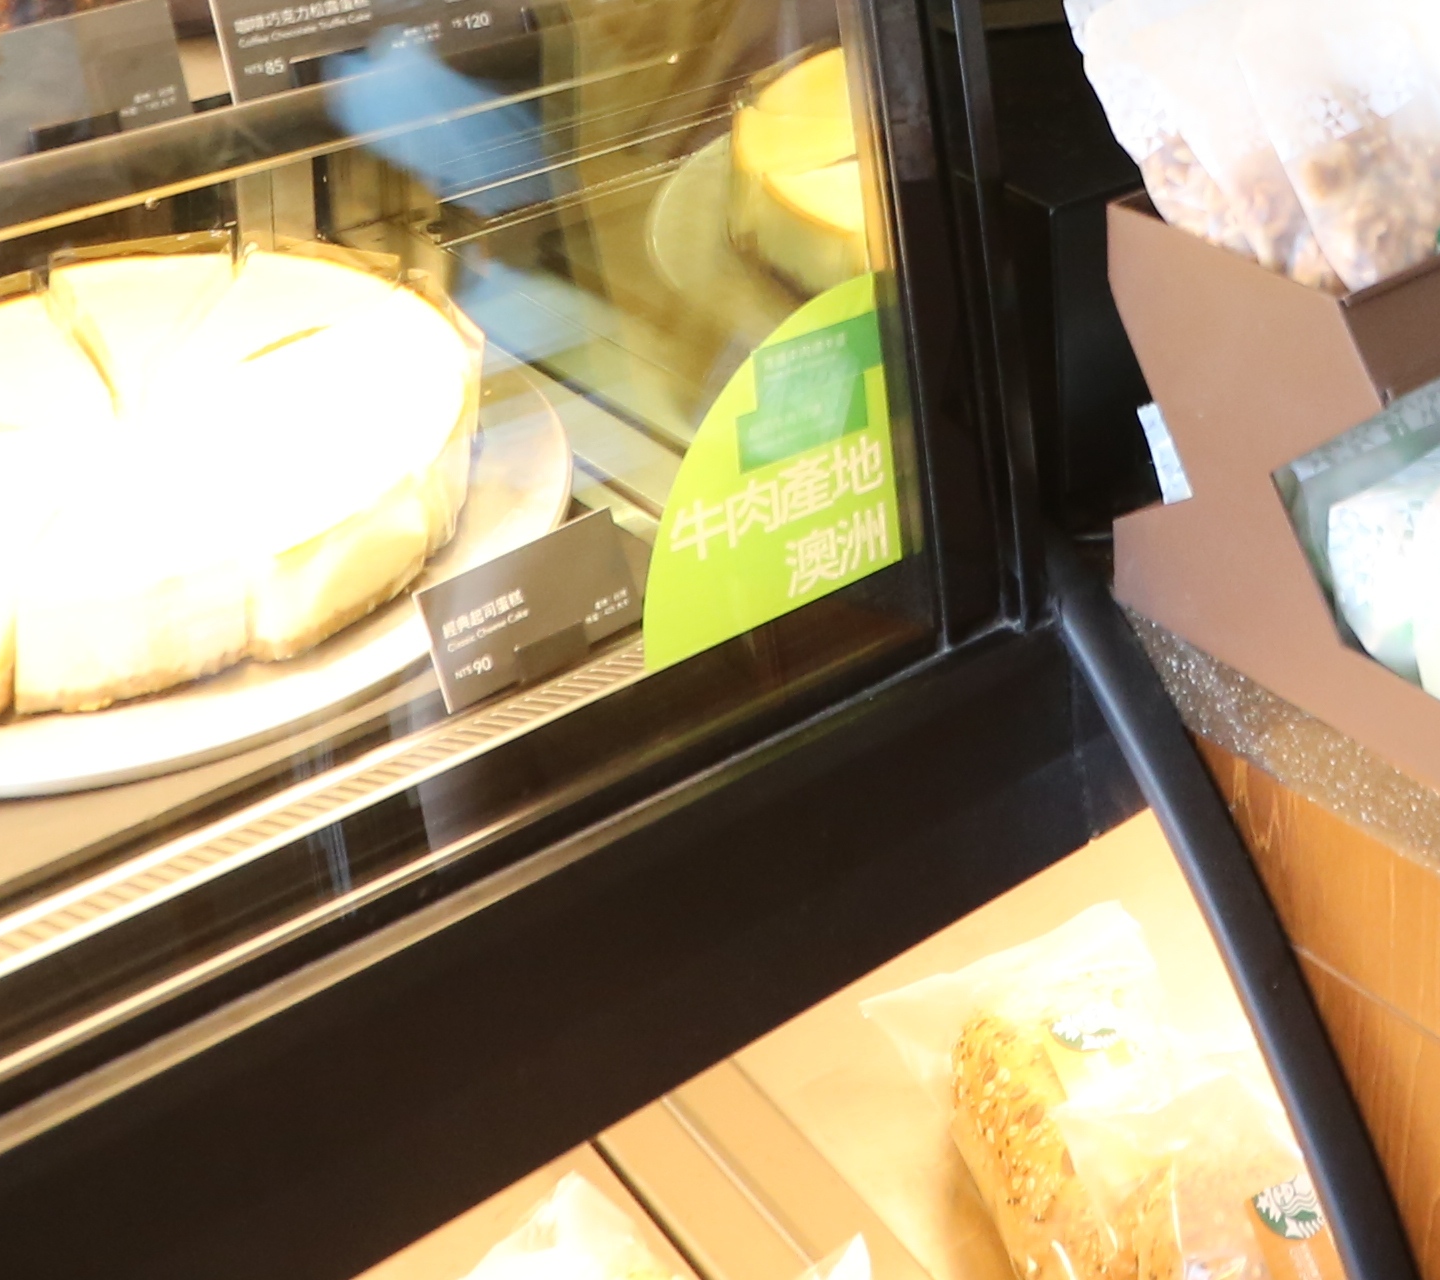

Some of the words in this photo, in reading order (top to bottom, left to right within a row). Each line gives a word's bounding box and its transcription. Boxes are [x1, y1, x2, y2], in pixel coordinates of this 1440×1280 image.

[669, 436, 885, 561] 牛肉產地
[785, 500, 890, 600] 澳洲
